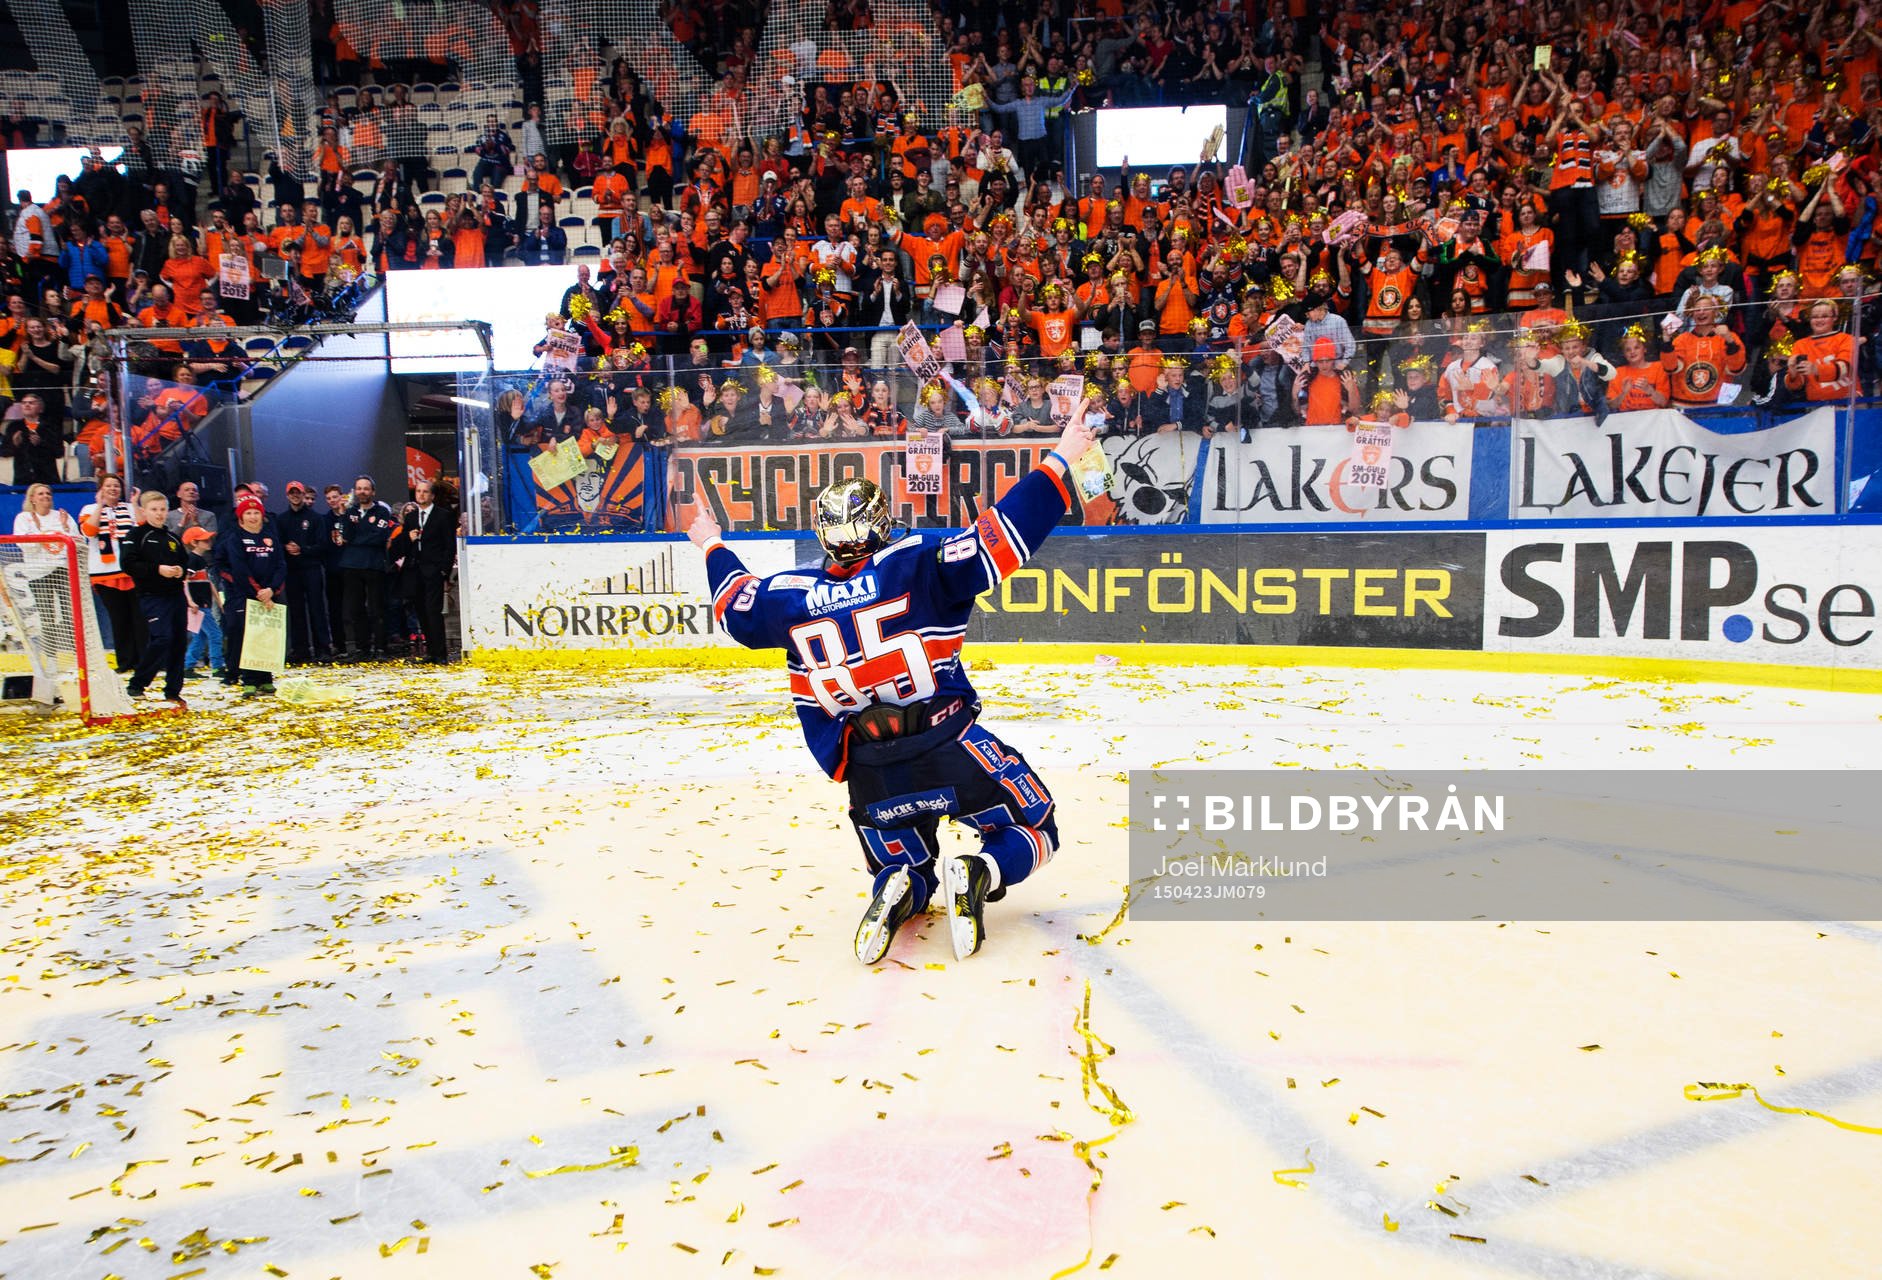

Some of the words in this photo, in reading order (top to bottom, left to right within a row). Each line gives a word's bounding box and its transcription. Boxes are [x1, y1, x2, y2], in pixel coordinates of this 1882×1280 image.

[223, 287, 248, 298] 2015
[1356, 436, 1391, 447] GRATTIS!
[908, 447, 940, 455] GRATTIS!
[1352, 464, 1387, 475] SM-GULD
[908, 474, 940, 482] SM-GULD
[1351, 472, 1385, 486] 2015
[909, 481, 940, 492] 2015
[806, 575, 876, 610] MAXI
[821, 592, 877, 614] STORMARKNAD
[789, 592, 938, 719] 85
[930, 698, 963, 727] CC
